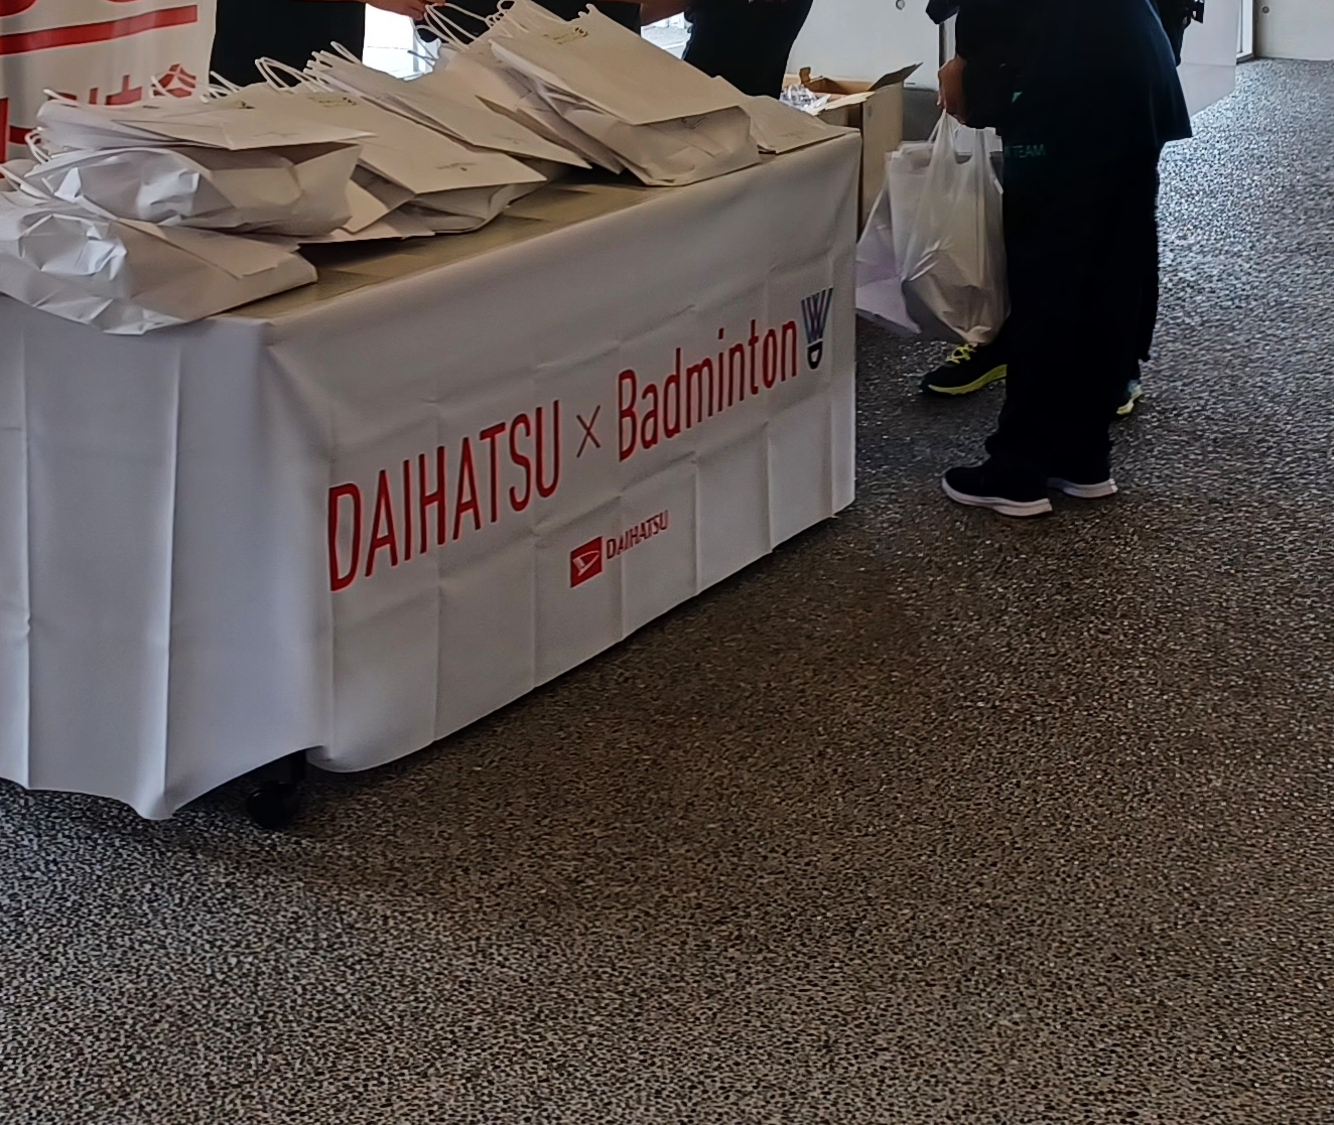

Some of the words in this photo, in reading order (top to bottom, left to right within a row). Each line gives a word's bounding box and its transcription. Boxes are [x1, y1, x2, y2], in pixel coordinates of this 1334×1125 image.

[327, 400, 562, 592] DAIHATSU
[618, 318, 798, 463] Badminton
[606, 509, 669, 560] DAIHATSU
